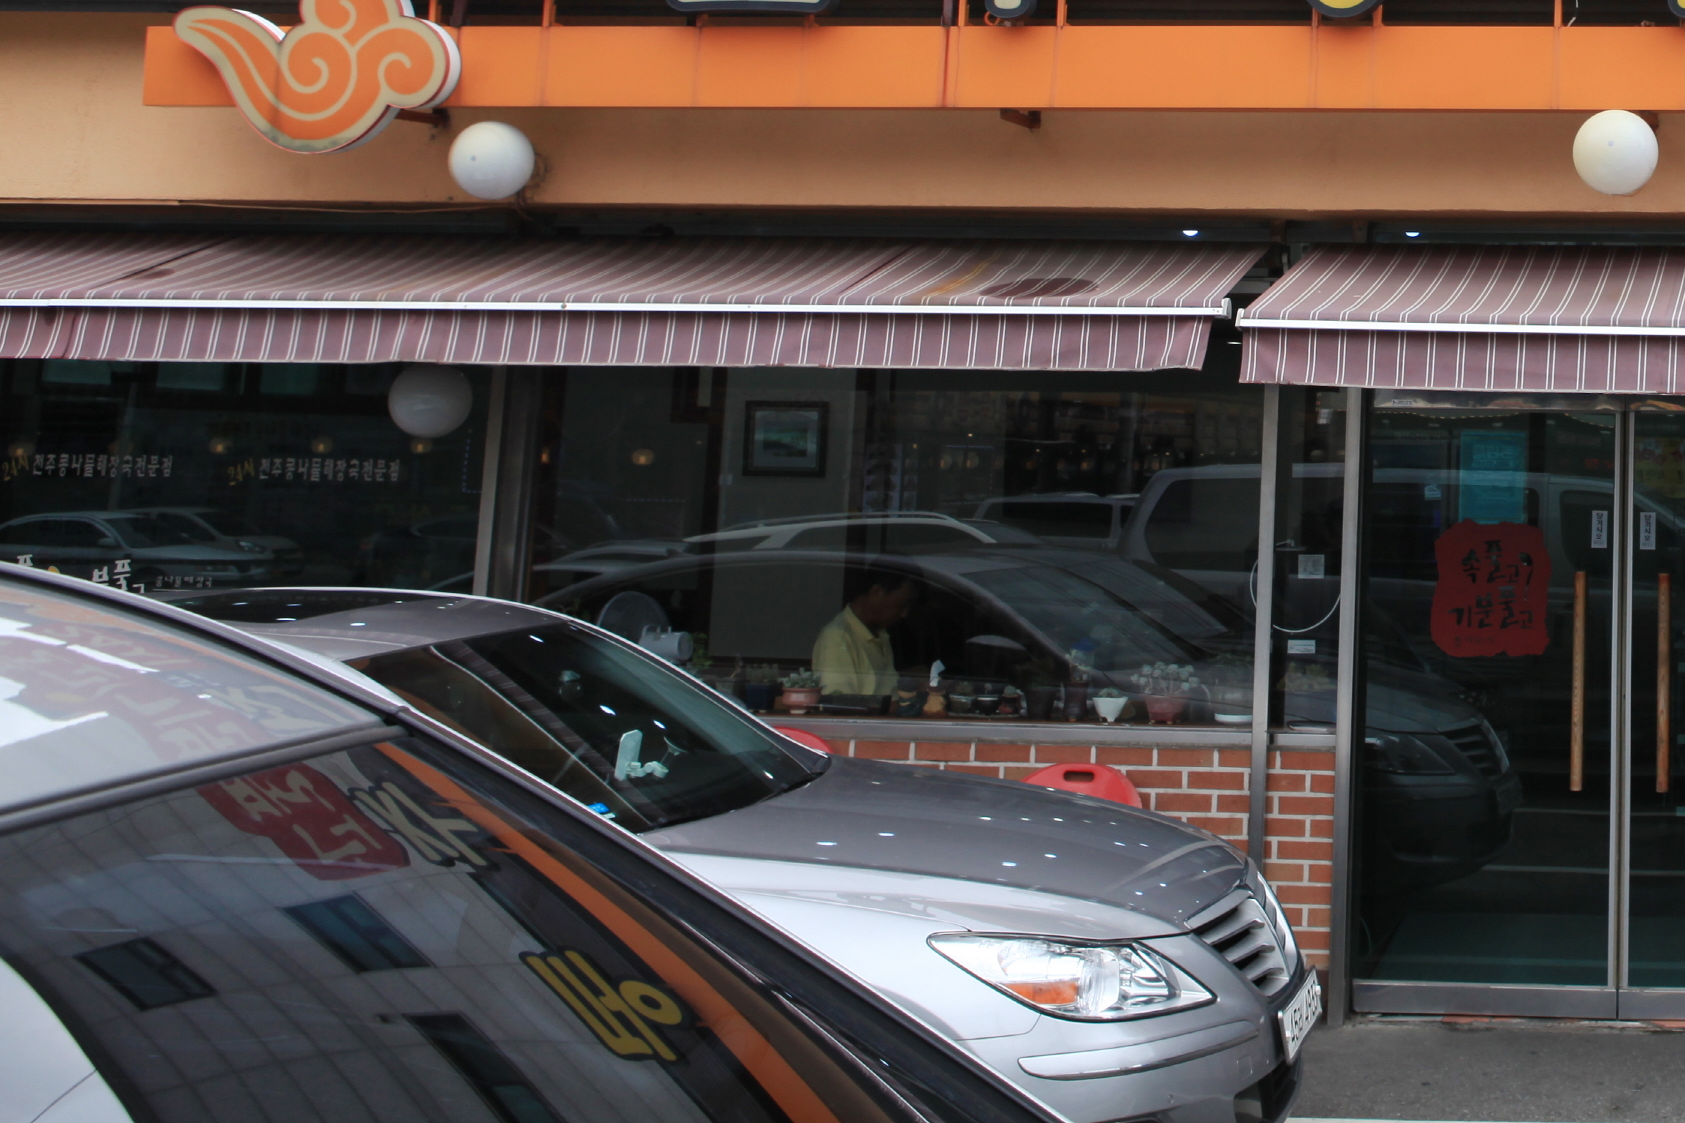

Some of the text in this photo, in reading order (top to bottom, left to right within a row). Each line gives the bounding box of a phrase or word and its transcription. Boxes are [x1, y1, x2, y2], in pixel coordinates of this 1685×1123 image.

[1596, 513, 1604, 540] 당기시오
[1461, 540, 1520, 584] 속풀고
[1447, 586, 1533, 629] 기분풀고
